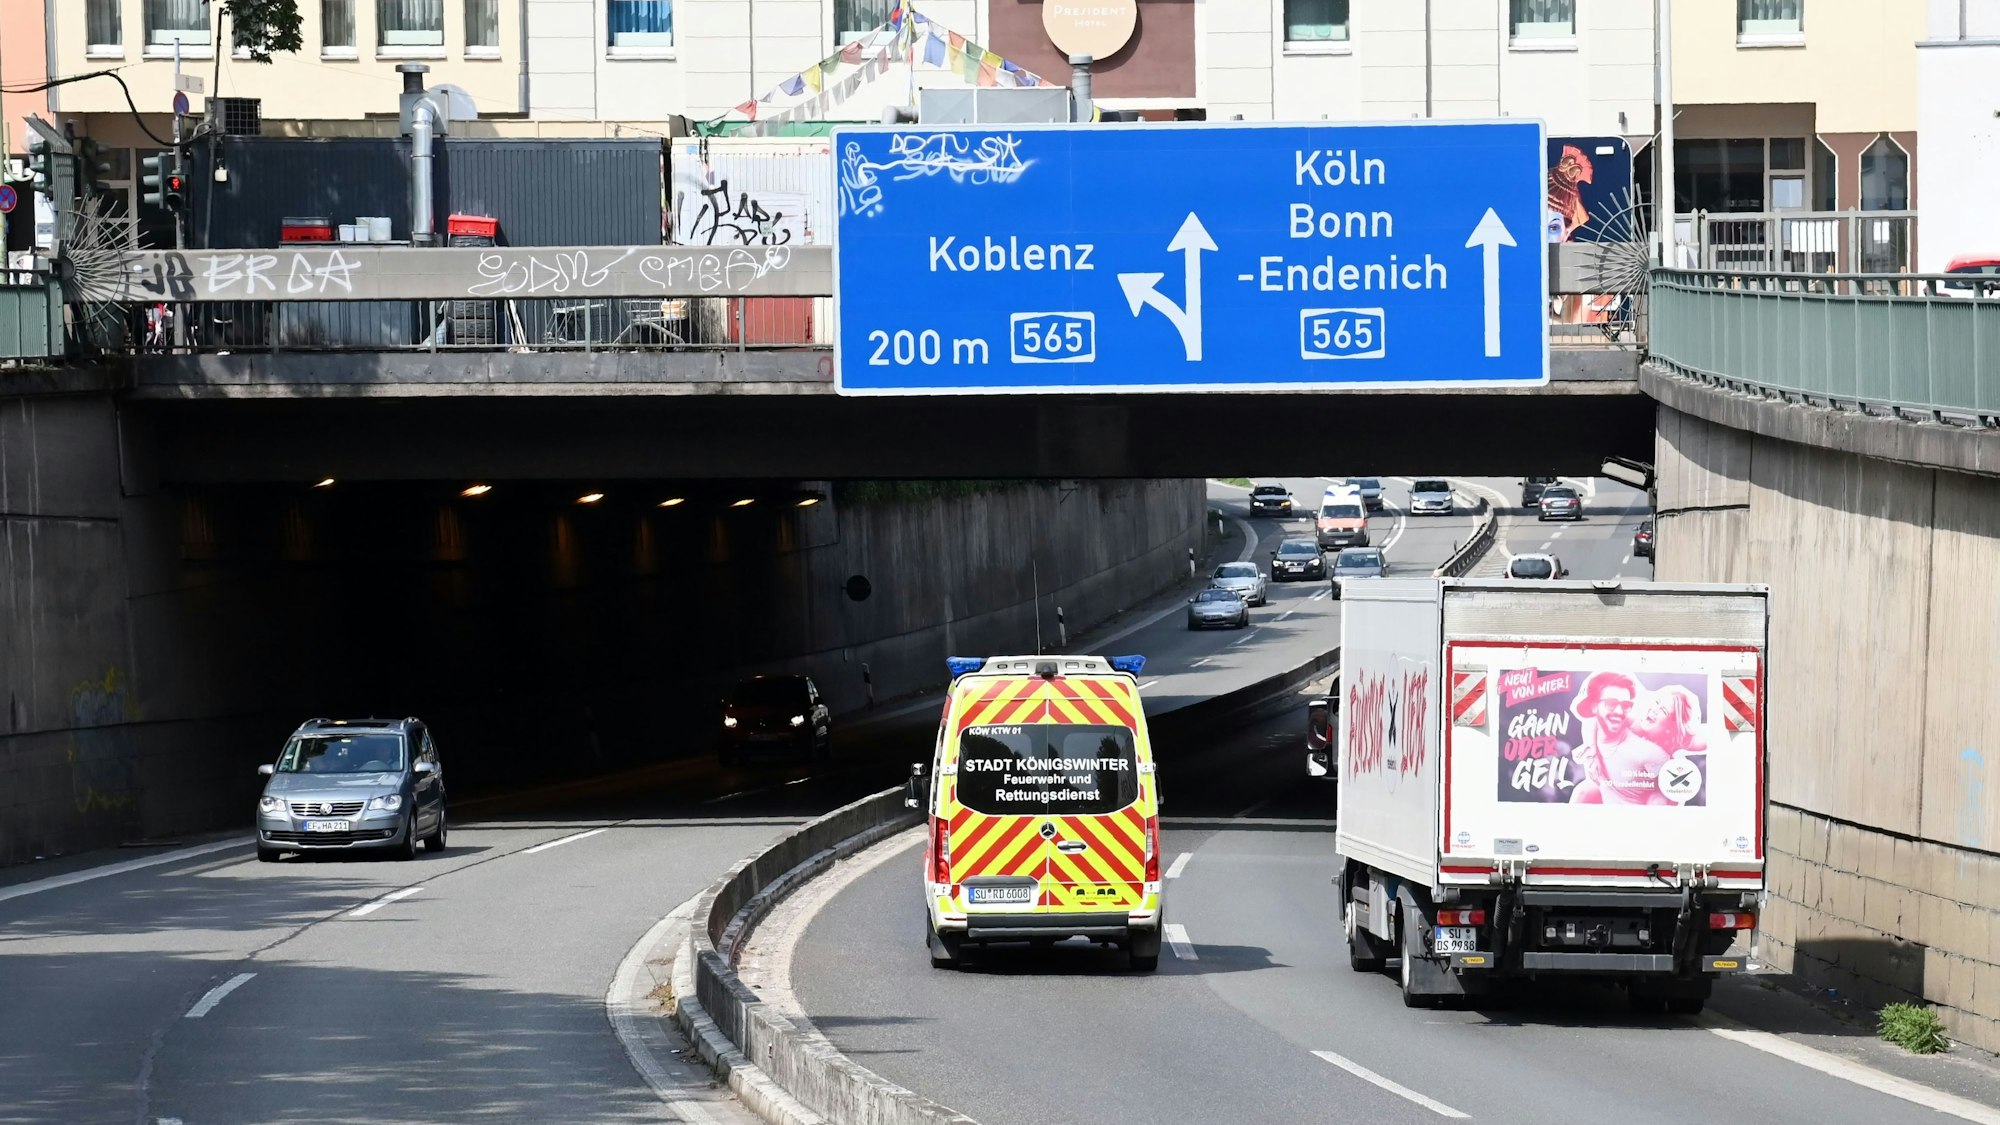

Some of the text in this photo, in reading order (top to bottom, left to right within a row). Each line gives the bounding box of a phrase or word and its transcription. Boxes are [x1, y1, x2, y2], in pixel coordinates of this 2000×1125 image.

[1054, 5, 1126, 18] PRESIDENT
[1075, 18, 1107, 28] HOTEL
[1295, 149, 1386, 186] Köln
[1289, 203, 1393, 239] Bonn
[929, 236, 1095, 272] Koblenz
[1237, 253, 1448, 291] -Endenich
[1023, 322, 1083, 353] 565
[1313, 318, 1373, 349] 565
[868, 329, 989, 366] 200 m
[1504, 670, 1533, 687] NEU!
[1511, 674, 1570, 700] VON HIER!
[968, 726, 1023, 736] KÖW KTW 01
[1507, 709, 1570, 740] GÄHN
[1504, 736, 1559, 761] ODER
[965, 756, 1129, 772] STADT KÖNIGSWINTER
[1511, 756, 1575, 792] GEIL
[1003, 774, 1092, 785] Feuerwehr und
[995, 789, 1101, 803] Rettungsdienst
[334, 821, 347, 829] 211
[975, 888, 1029, 900] SU RD 6008
[1448, 928, 1461, 939] SU
[1437, 940, 1449, 951] DS
